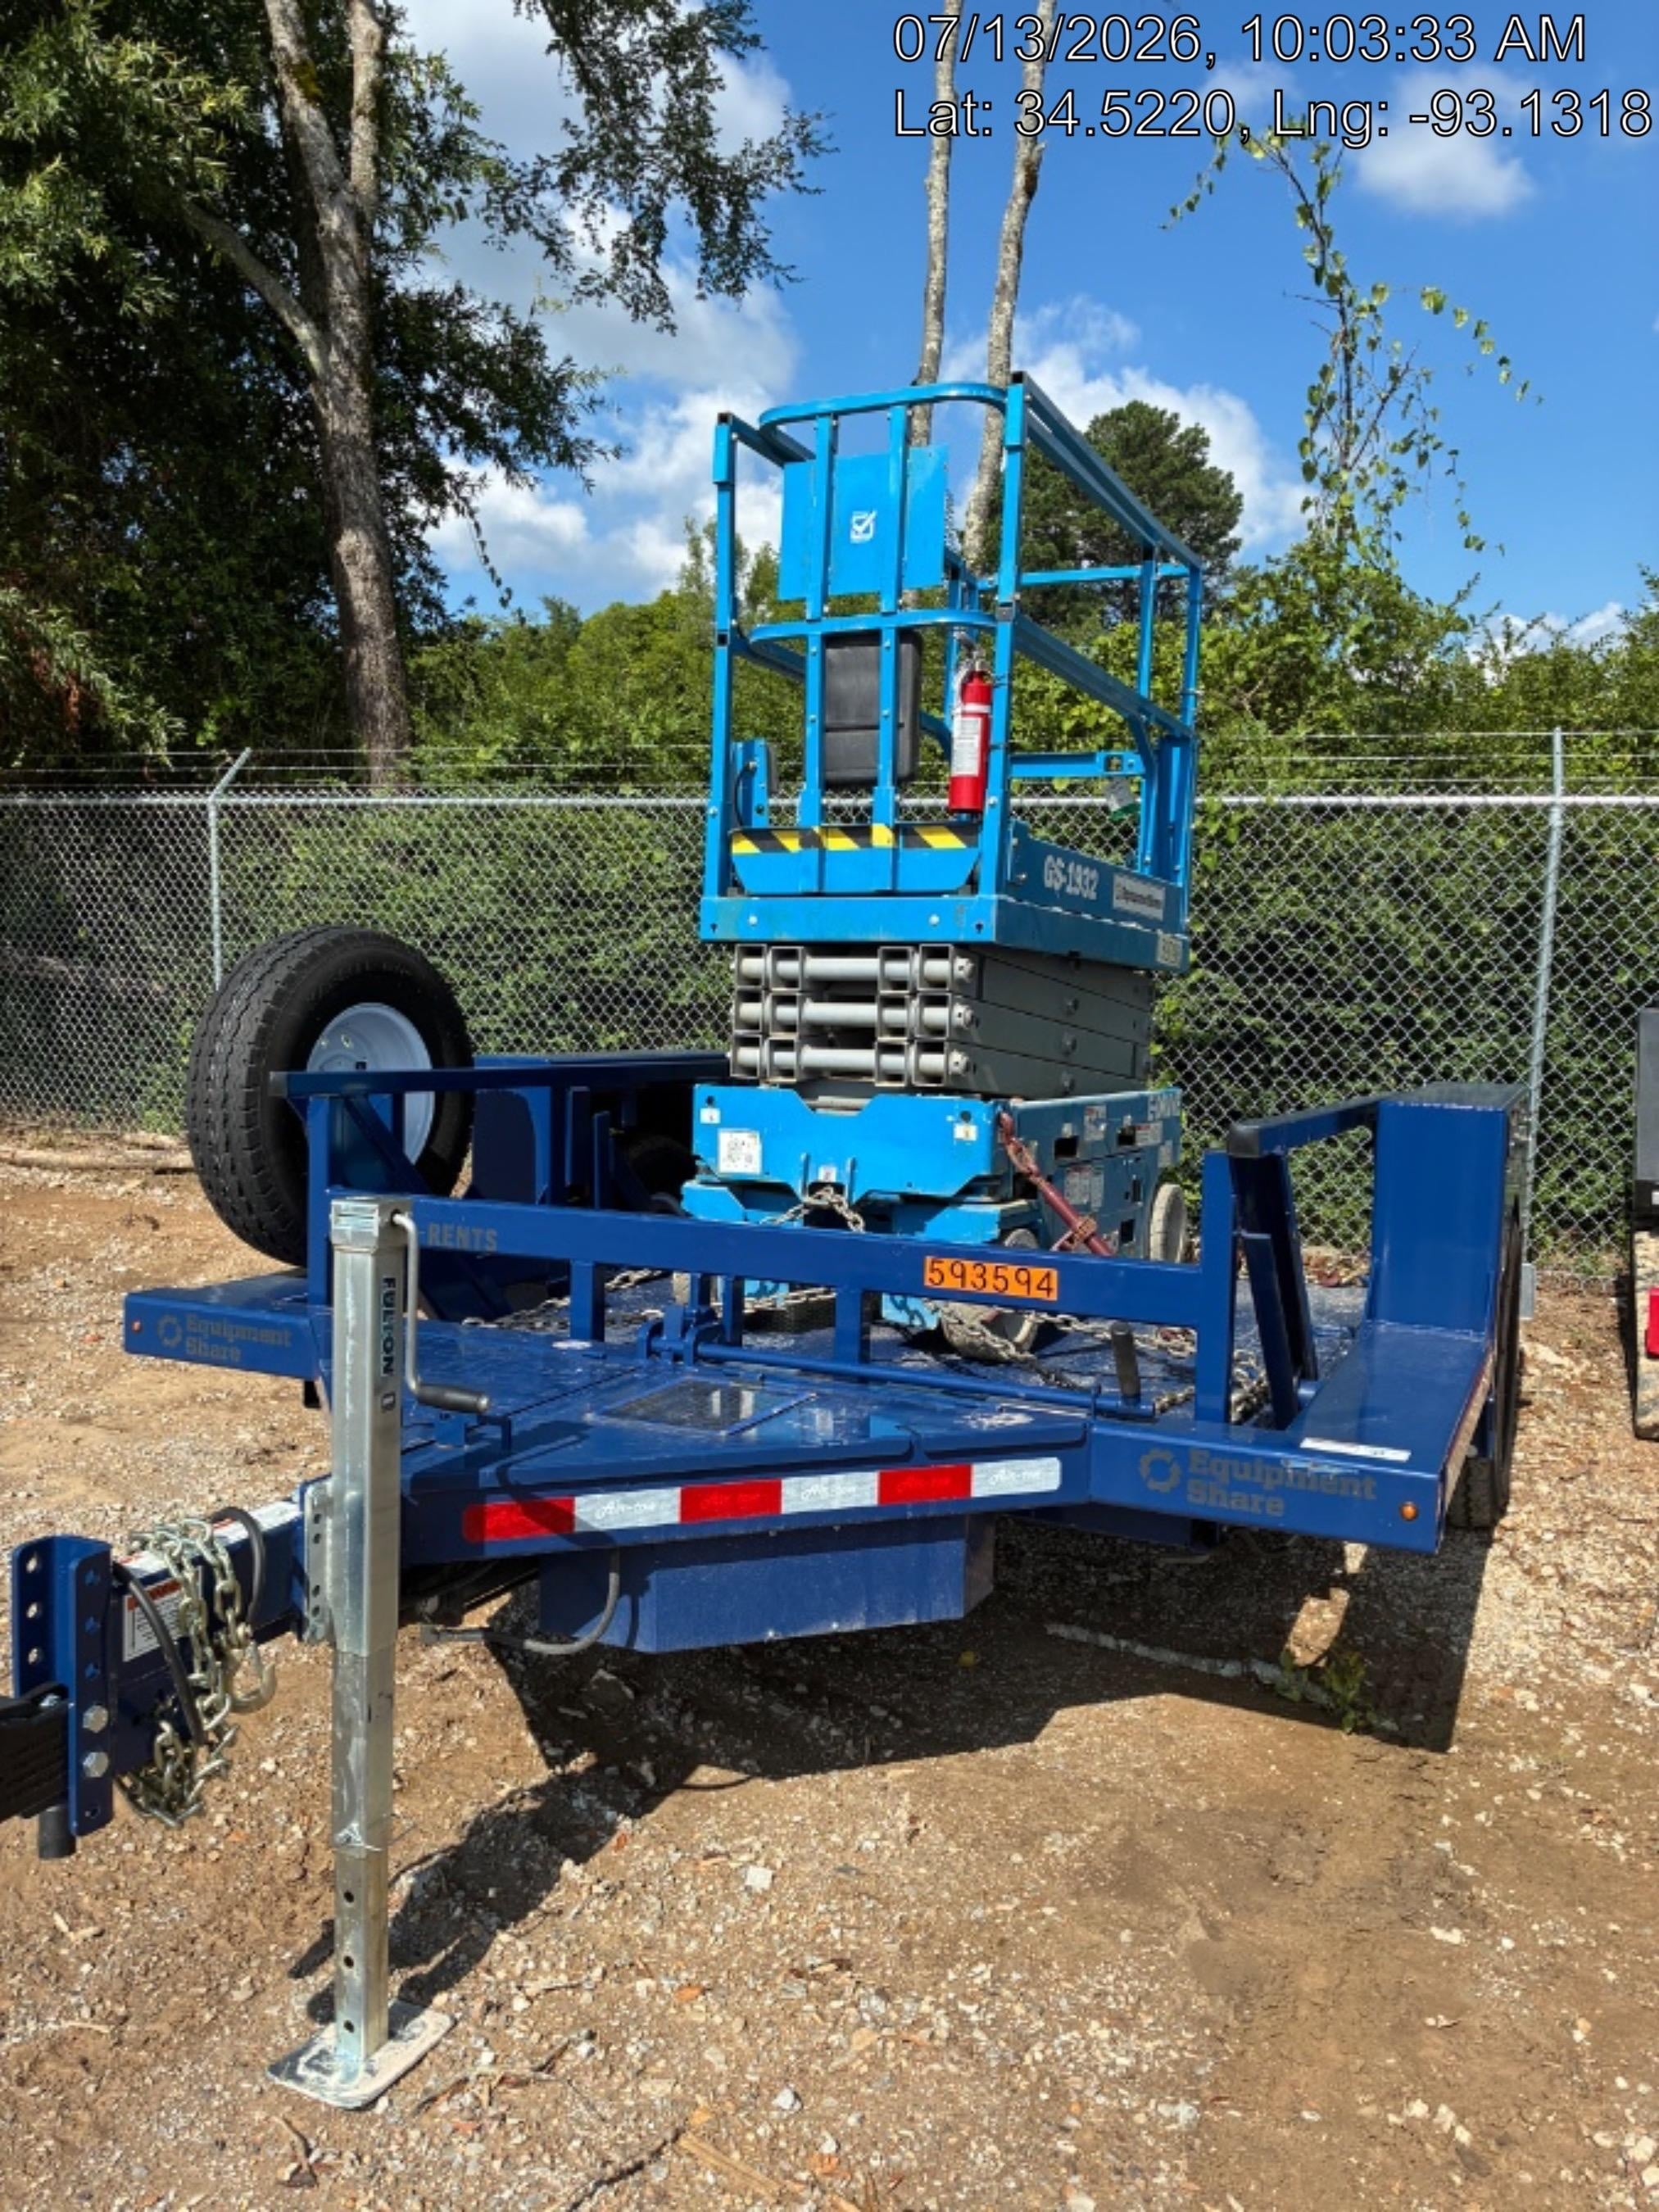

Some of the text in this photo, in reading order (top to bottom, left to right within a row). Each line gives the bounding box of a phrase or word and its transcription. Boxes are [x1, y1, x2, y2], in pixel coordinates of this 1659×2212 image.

[428, 1222, 497, 1253] RENTS
[928, 1259, 1053, 1298] 593594
[186, 1314, 292, 1347] Equipment
[381, 1277, 397, 1376] FULTON
[186, 1336, 242, 1362] Share
[1188, 1449, 1376, 1500] Equipment
[1188, 1479, 1285, 1516] Share
